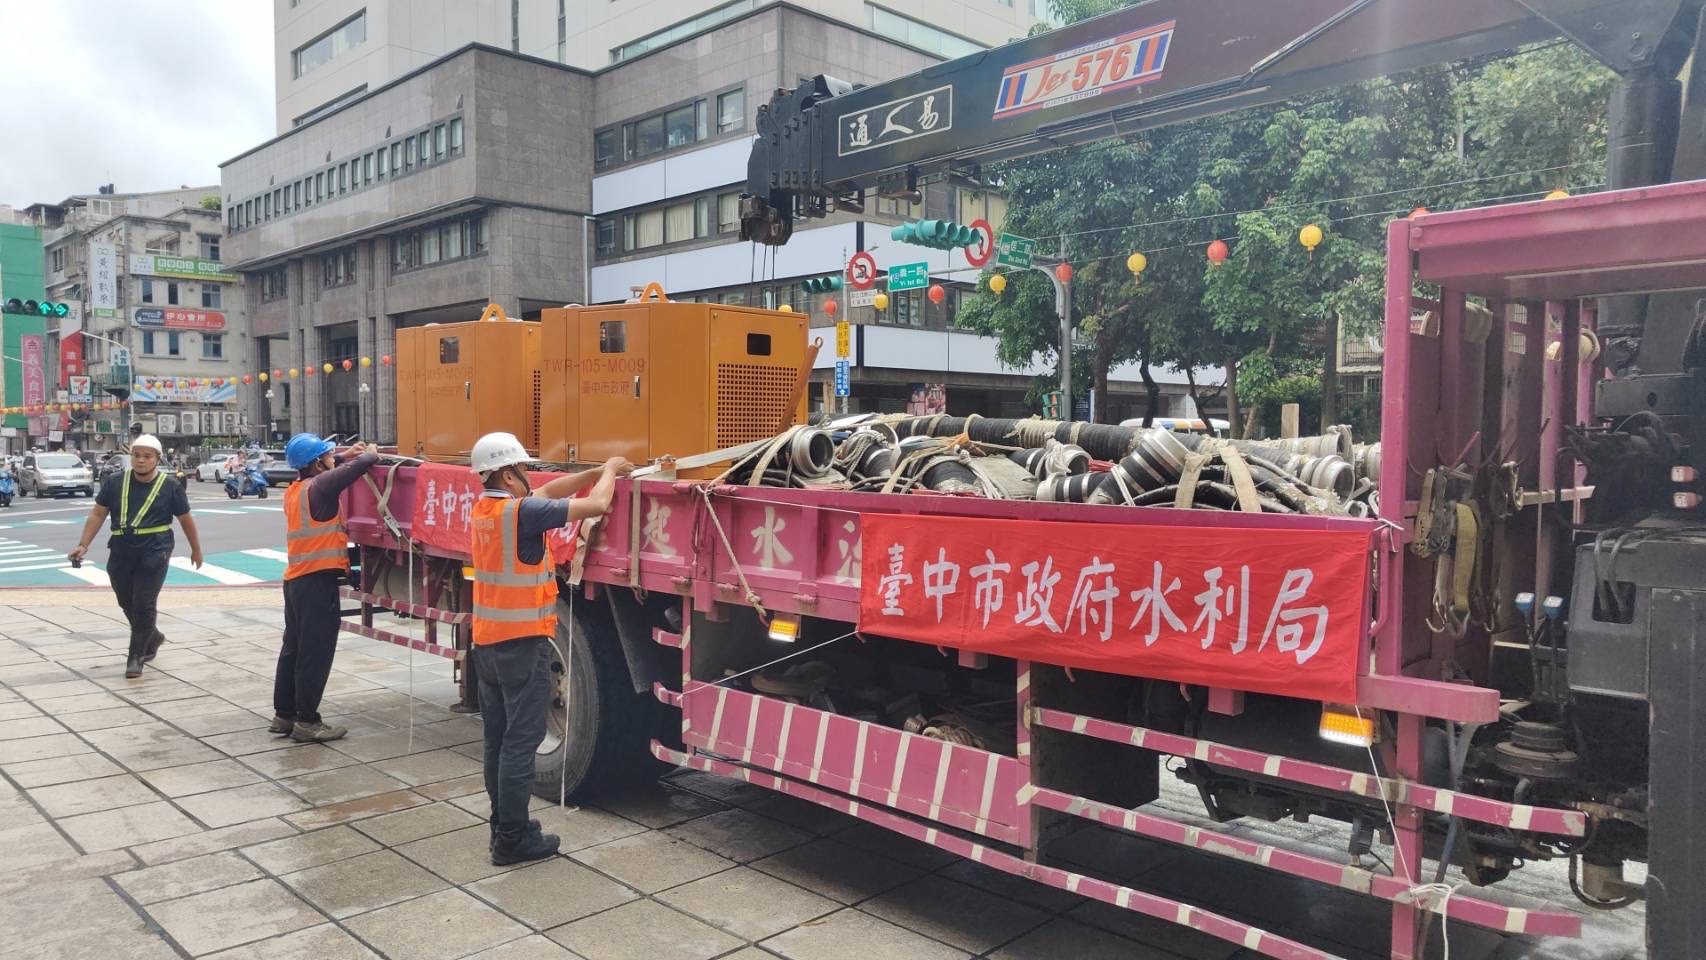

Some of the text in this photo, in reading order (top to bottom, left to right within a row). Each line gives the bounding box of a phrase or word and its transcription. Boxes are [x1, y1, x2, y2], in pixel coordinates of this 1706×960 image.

[1072, 44, 1132, 91] 576
[543, 358, 646, 374] TWR-105-M009
[582, 380, 630, 395] 臺中市政府
[877, 543, 1329, 664] 臺中市政府水利局
